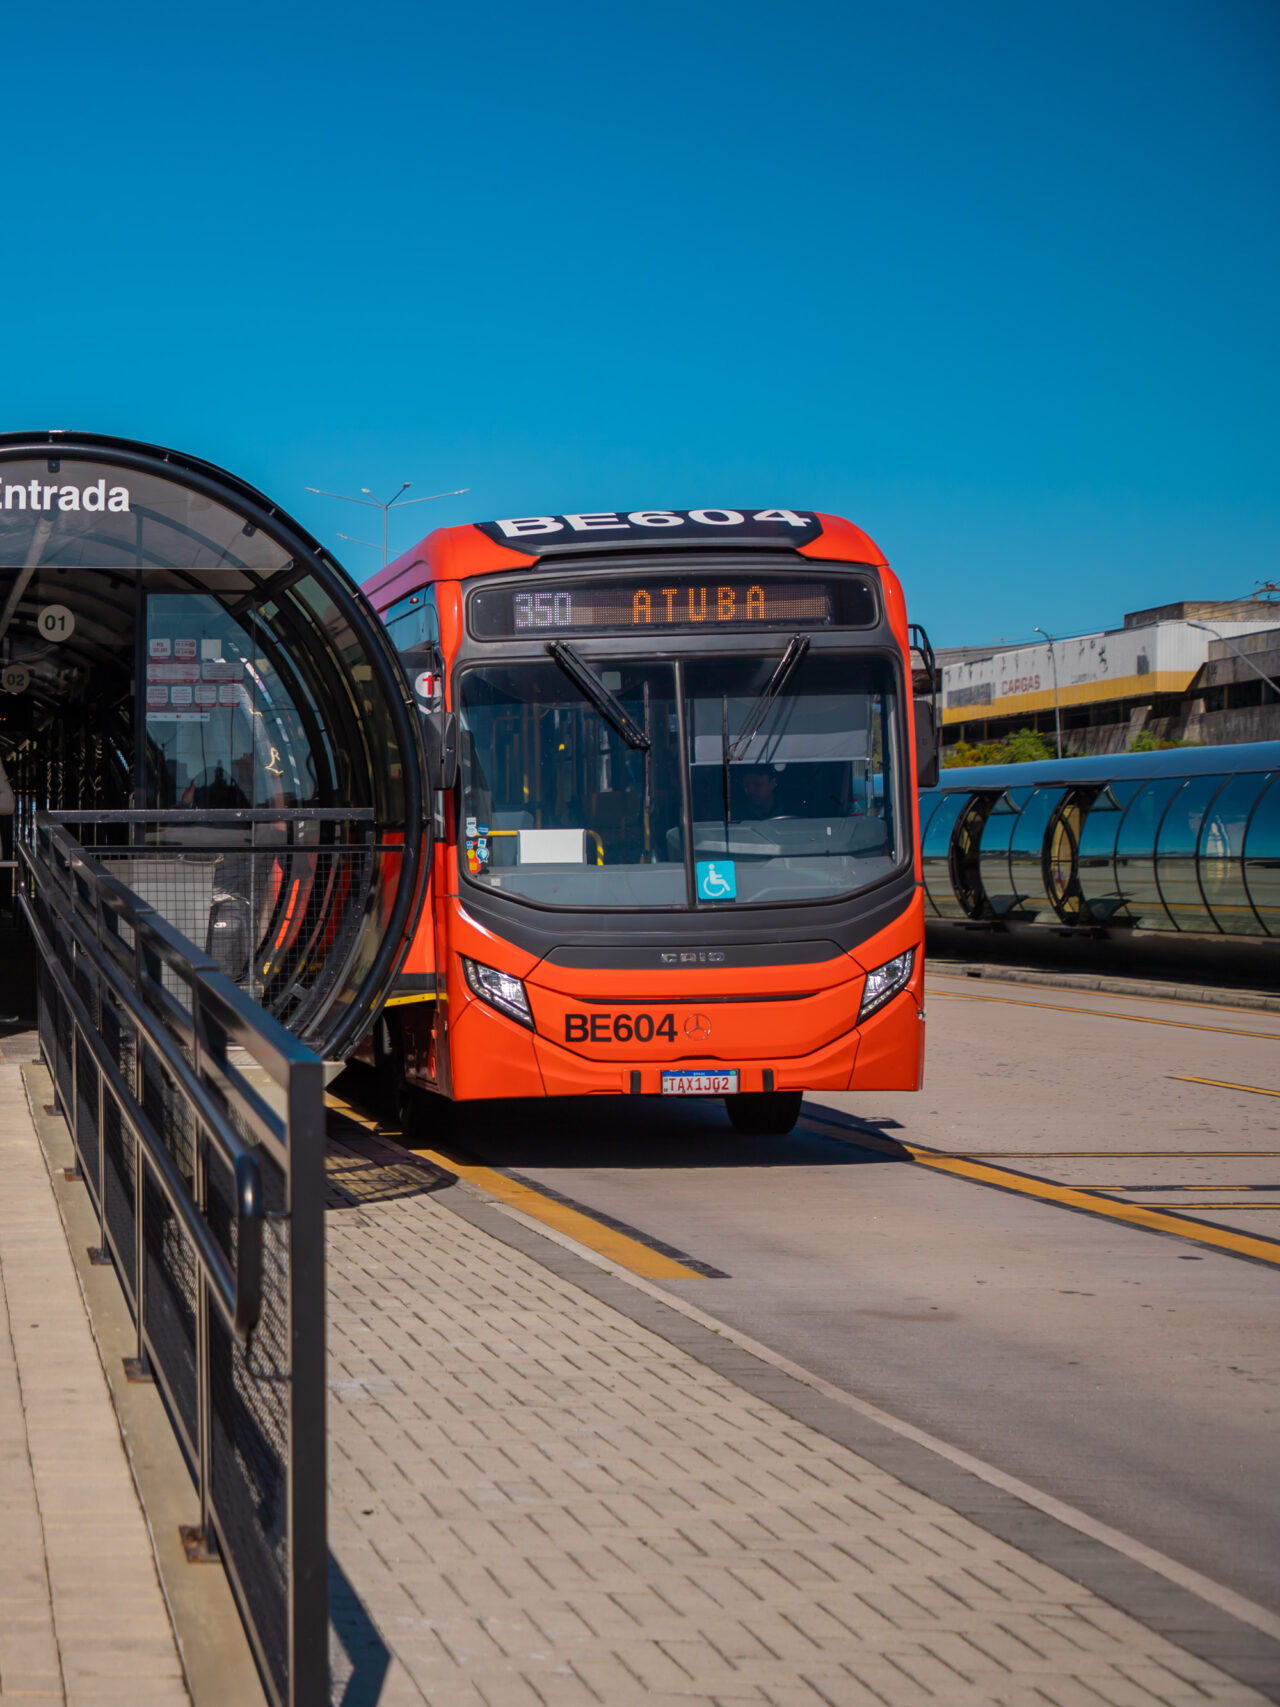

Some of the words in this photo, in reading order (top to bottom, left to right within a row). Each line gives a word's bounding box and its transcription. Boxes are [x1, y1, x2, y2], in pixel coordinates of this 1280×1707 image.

[495, 509, 811, 538] BE604
[516, 592, 572, 627] 350
[633, 585, 764, 623] ATUBA
[44, 615, 66, 631] 01
[6, 673, 25, 686] 02
[1001, 674, 1040, 695] CARGAS
[565, 1013, 678, 1042] BE604
